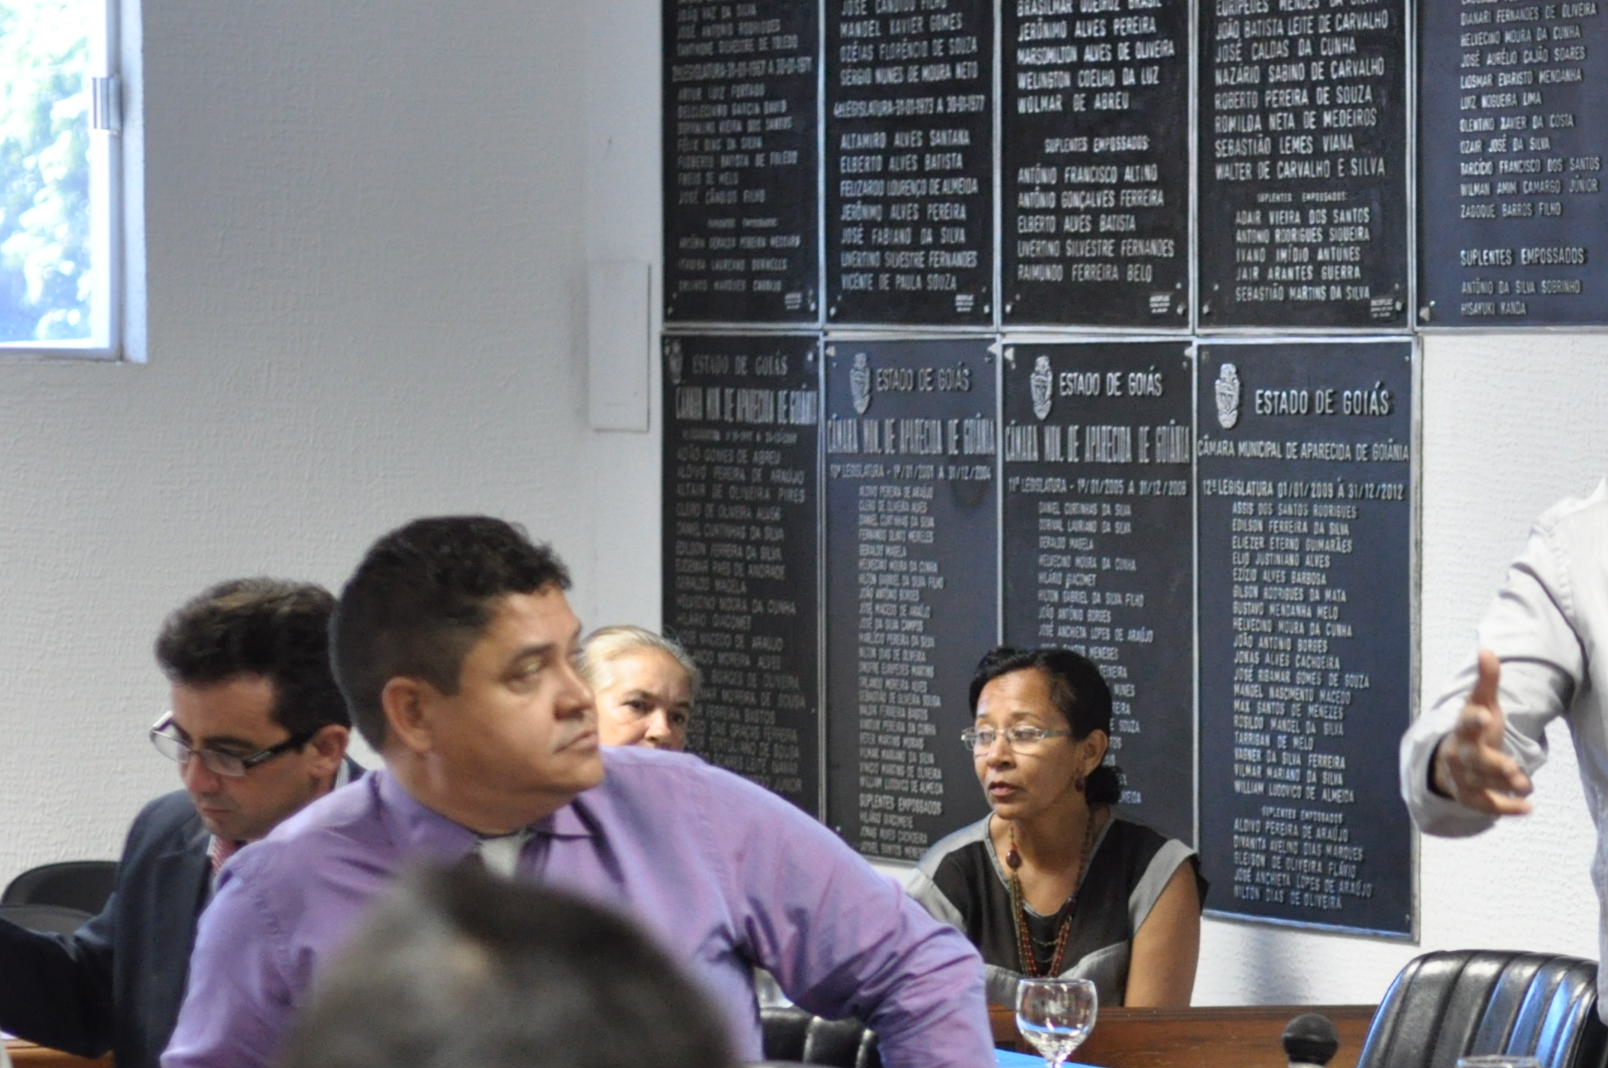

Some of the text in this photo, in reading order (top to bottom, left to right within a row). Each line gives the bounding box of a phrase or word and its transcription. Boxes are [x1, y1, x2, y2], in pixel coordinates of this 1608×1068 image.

[1215, 11, 1388, 40] JOÃO BATISTA LEITE DE CARVALHO
[1215, 37, 1355, 62] JOSÉ CALDAS DA CUNHA
[1268, 64, 1305, 83] SABINO
[1310, 63, 1324, 80] DE
[1330, 59, 1384, 79] CARVALHO
[1214, 86, 1372, 110] ROBERTO PEREIRA DE SOUZA
[1268, 113, 1295, 131] NETA
[1302, 112, 1316, 129] DE
[1322, 109, 1376, 128] MEDEIROS
[1214, 135, 1354, 157] SEBASTIÃO LEMES VIANA
[1214, 160, 1385, 180] WALTER DE CARVALHO E SILVA
[1235, 208, 1369, 225] ADAIR VIEIRA DOS SANTOS
[1236, 265, 1360, 281] JAIR ARANTES GUERRA
[875, 364, 969, 391] ESTADO DE GOIÁS
[1059, 368, 1161, 395] ESTADO DE GOIÁS
